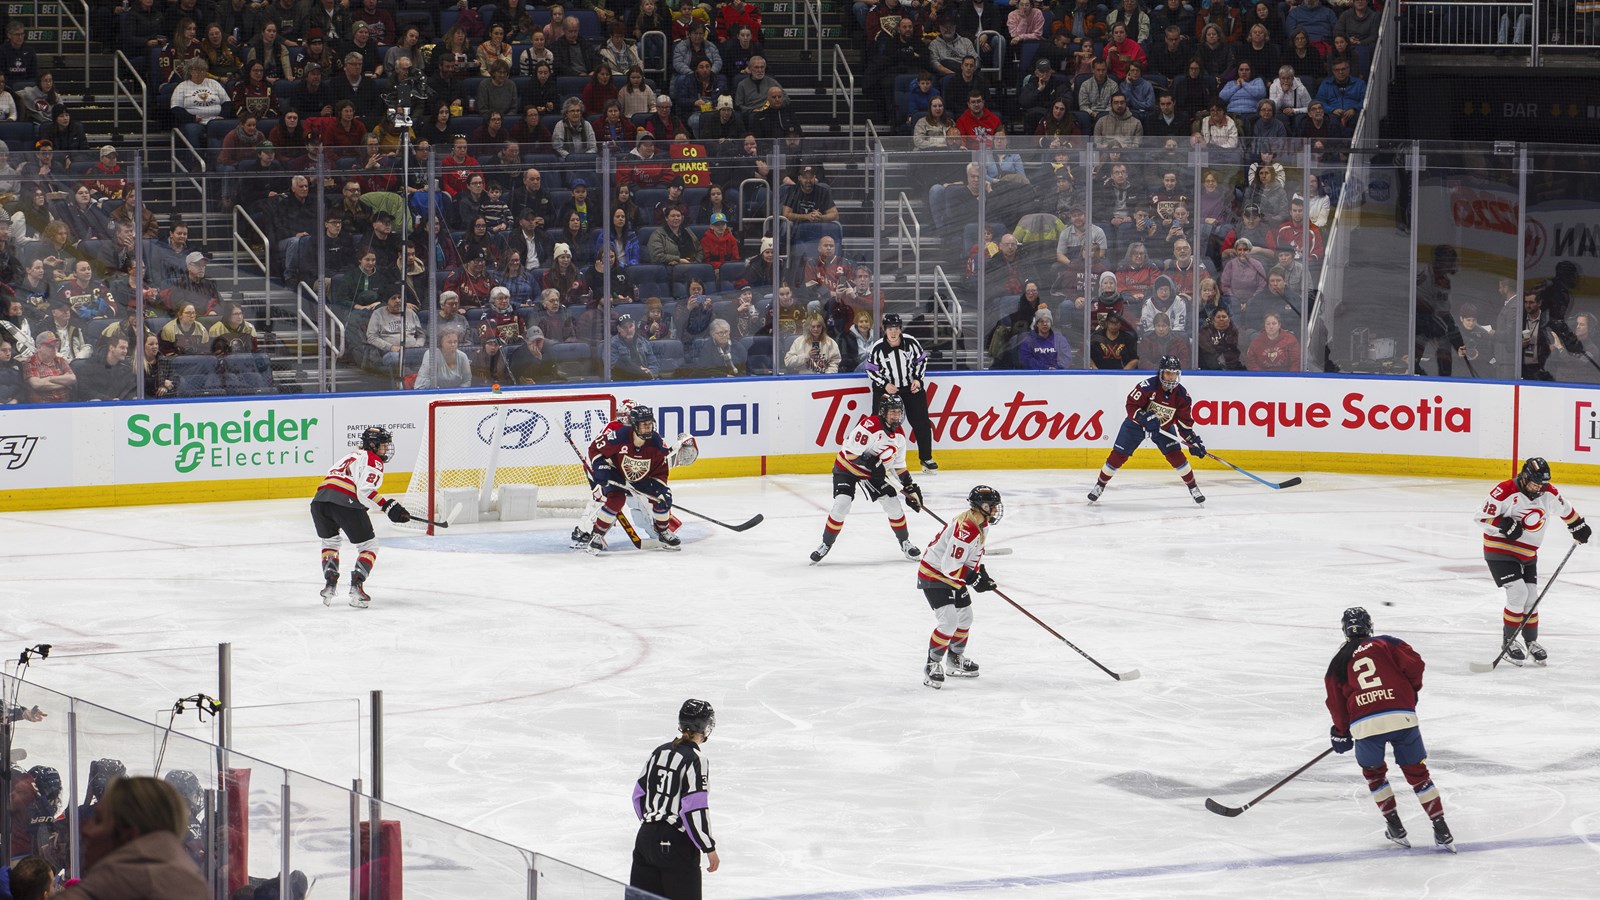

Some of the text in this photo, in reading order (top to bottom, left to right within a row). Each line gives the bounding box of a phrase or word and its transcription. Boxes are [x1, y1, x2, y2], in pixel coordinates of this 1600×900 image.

[1503, 102, 1538, 118] BAR
[682, 147, 698, 158] GO
[671, 162, 708, 173] CHARGE
[682, 173, 699, 185] GO
[1129, 388, 1142, 401] 18
[564, 403, 760, 442] HNDAI
[812, 382, 1105, 448] Ti Hortons
[1191, 391, 1471, 438] anque Scotia
[127, 409, 318, 448] Schneider
[388, 422, 416, 430] OFFICIEL
[854, 431, 869, 446] 88
[211, 446, 314, 468] Electric
[366, 473, 381, 487] 21
[950, 544, 965, 560] 18
[1352, 642, 1373, 658] olson
[1352, 656, 1383, 690] 2
[1354, 688, 1396, 707] KEOPPLE
[656, 769, 674, 795] 31
